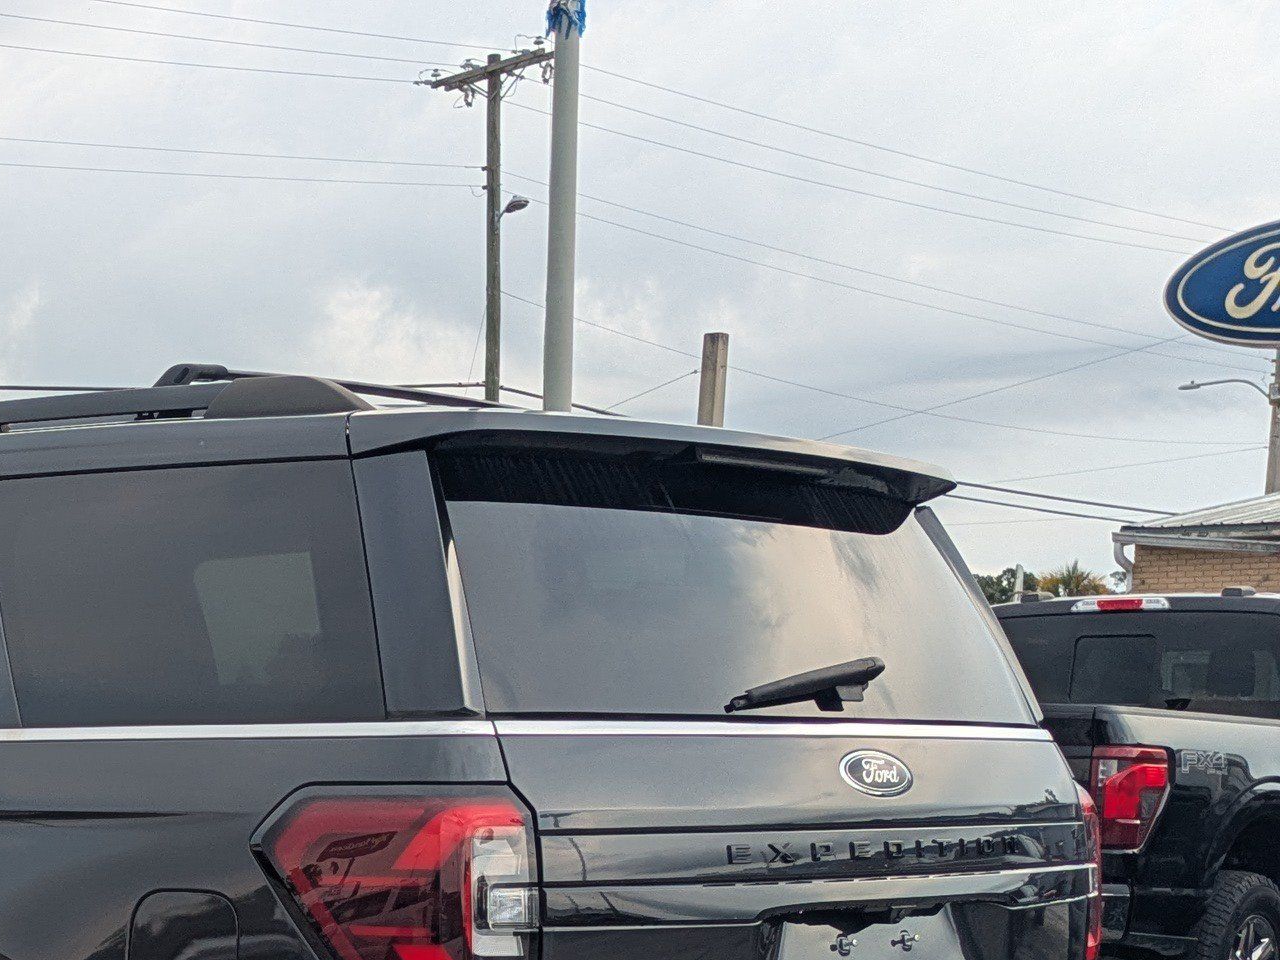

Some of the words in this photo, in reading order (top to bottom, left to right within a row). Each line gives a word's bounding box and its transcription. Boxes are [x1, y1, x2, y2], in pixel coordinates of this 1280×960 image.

[861, 758, 900, 784] Ford
[1181, 750, 1226, 774] FX4
[726, 836, 1022, 865] EXPEDITION
